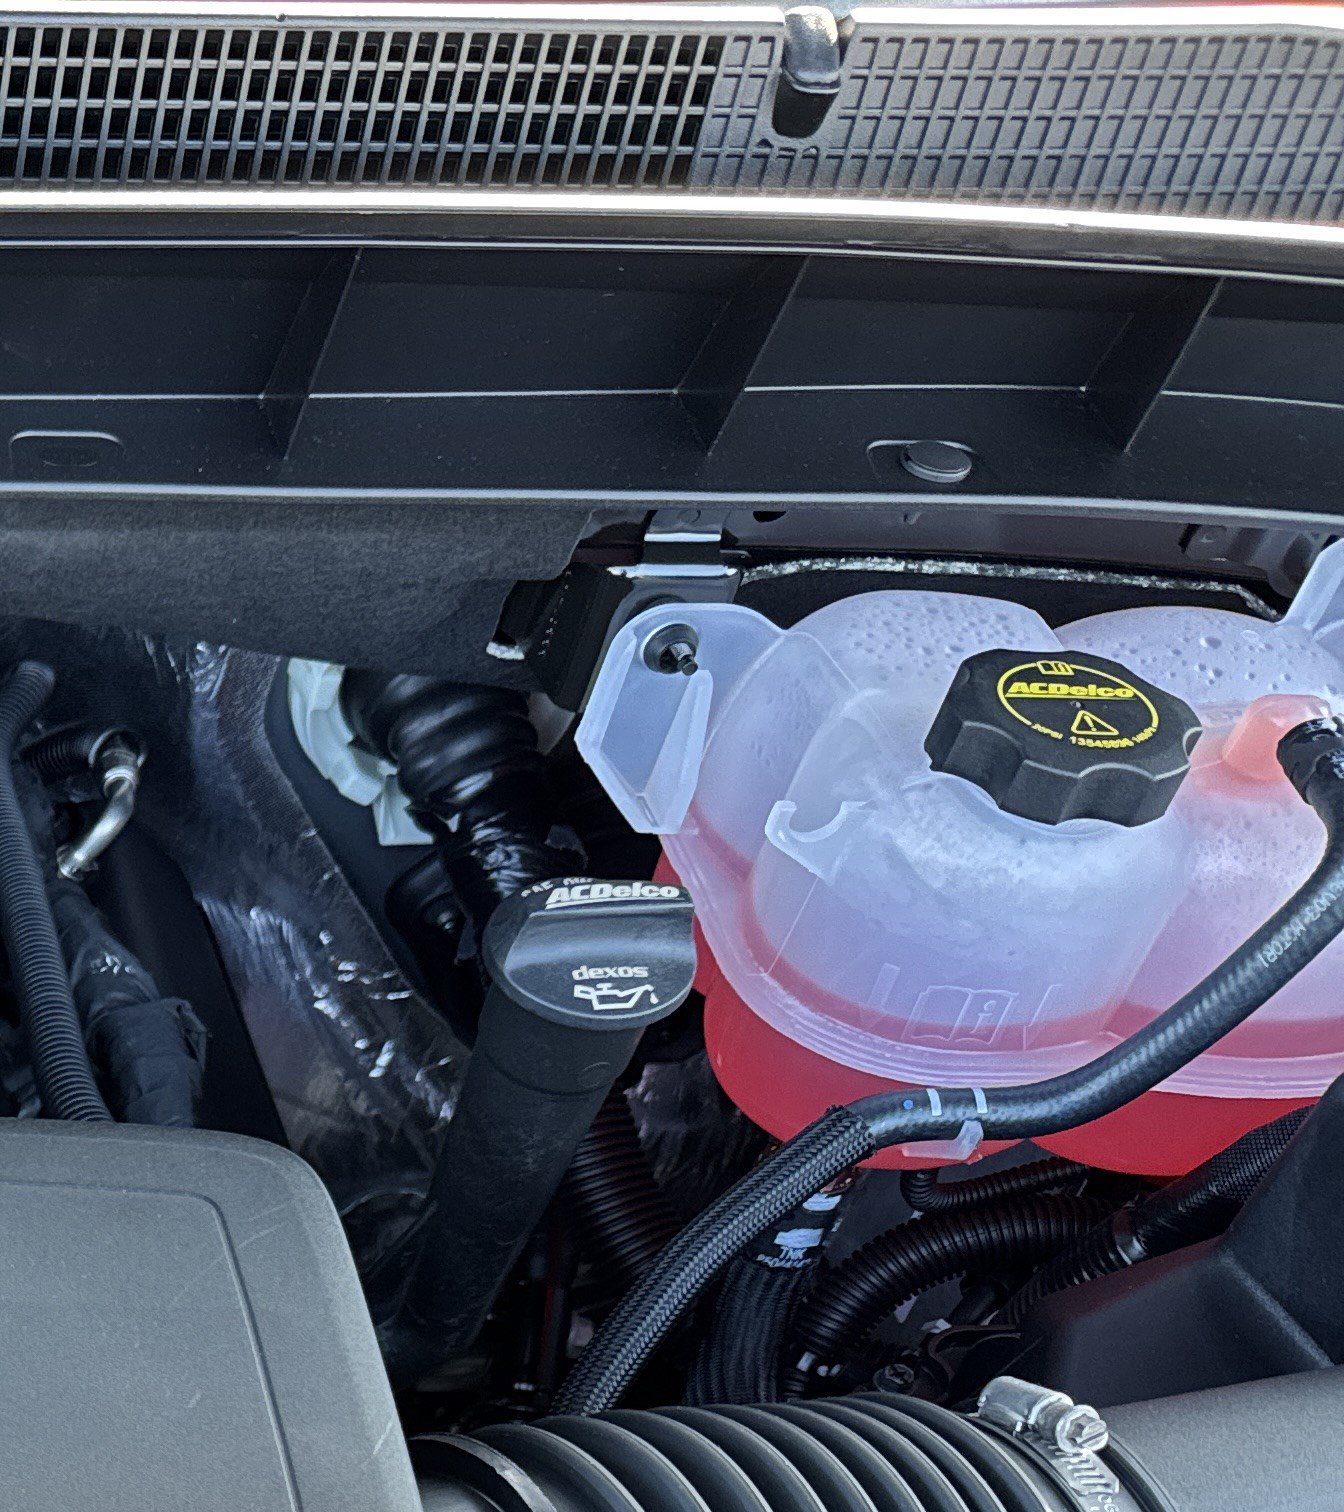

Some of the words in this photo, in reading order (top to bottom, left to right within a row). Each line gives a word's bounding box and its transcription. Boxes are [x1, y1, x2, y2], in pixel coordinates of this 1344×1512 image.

[1006, 681, 1135, 700] ACDelco
[544, 881, 681, 908] ACDelco
[571, 964, 650, 981] dexos
